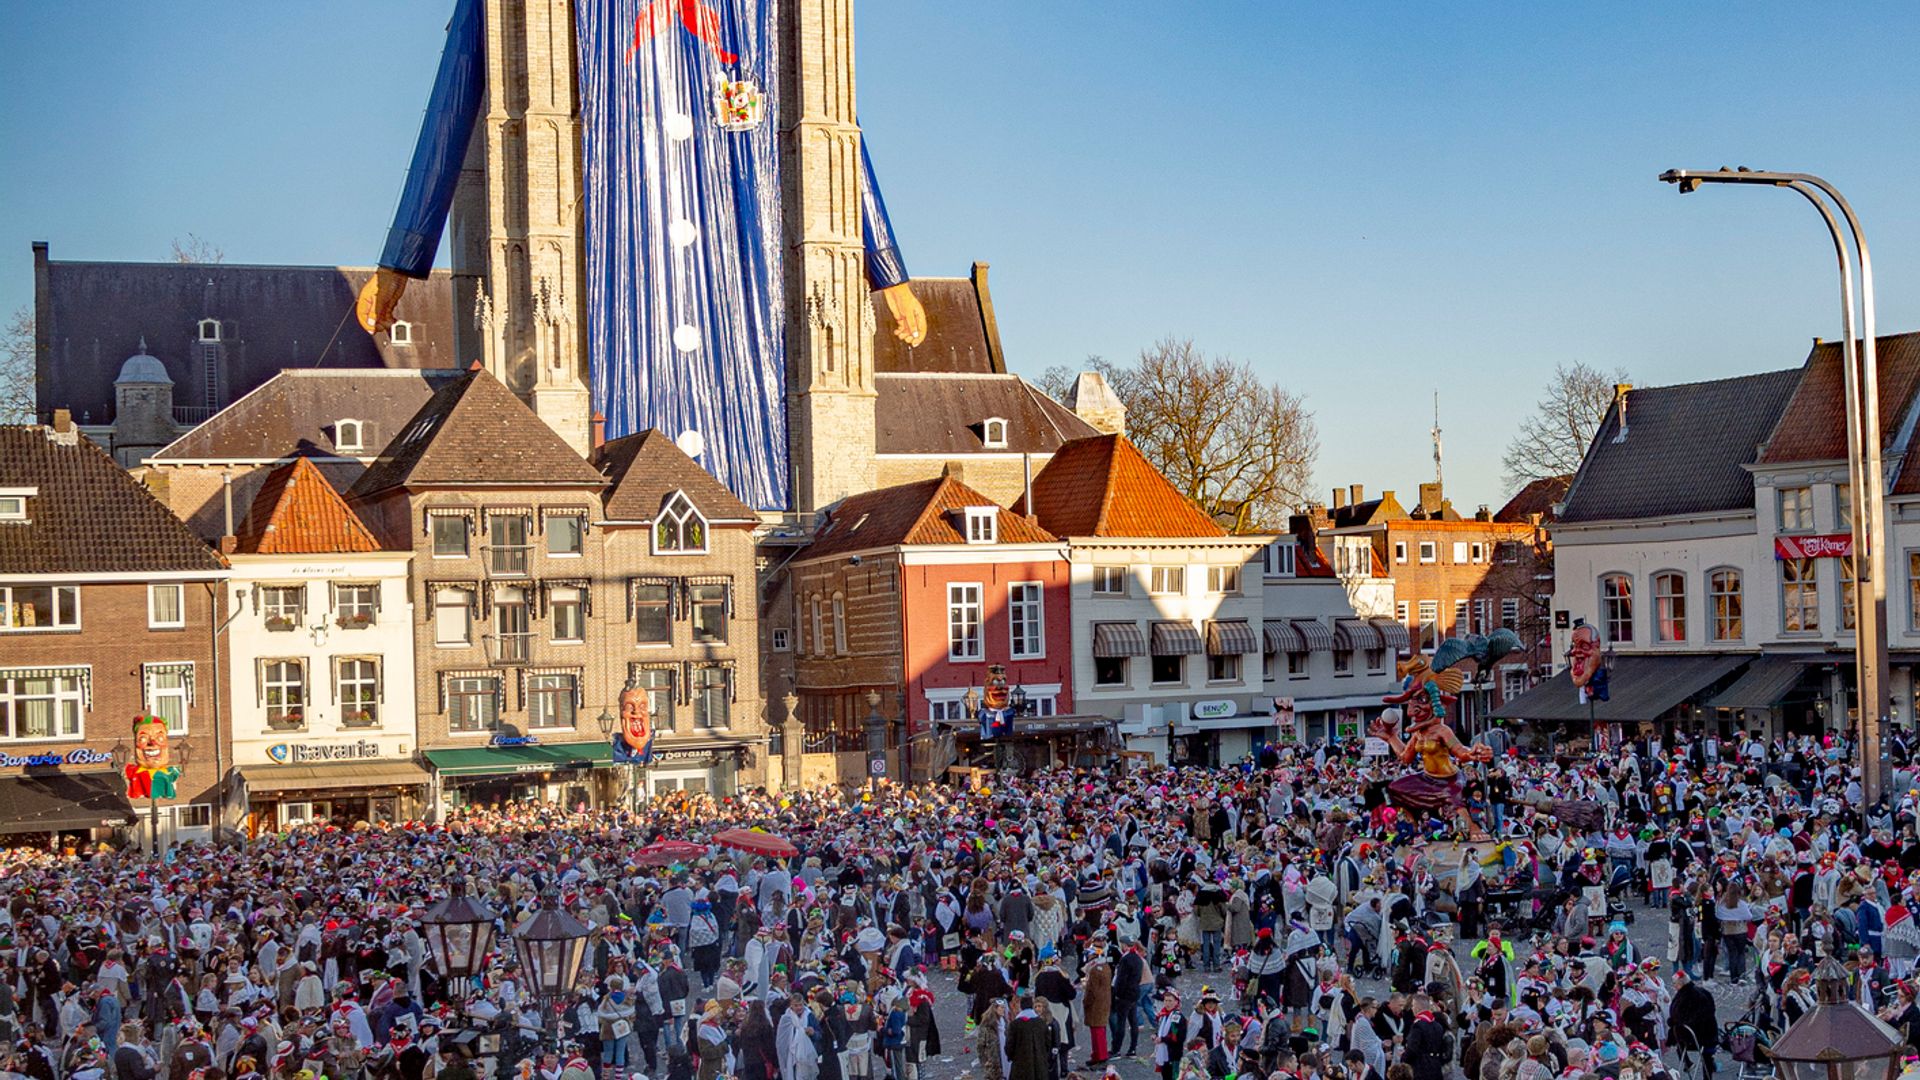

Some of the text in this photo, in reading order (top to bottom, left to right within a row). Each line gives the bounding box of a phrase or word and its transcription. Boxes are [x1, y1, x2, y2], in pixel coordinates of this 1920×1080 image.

[1203, 704, 1223, 712] BENU
[67, 747, 113, 764] Bier
[291, 739, 379, 763] Bavaria
